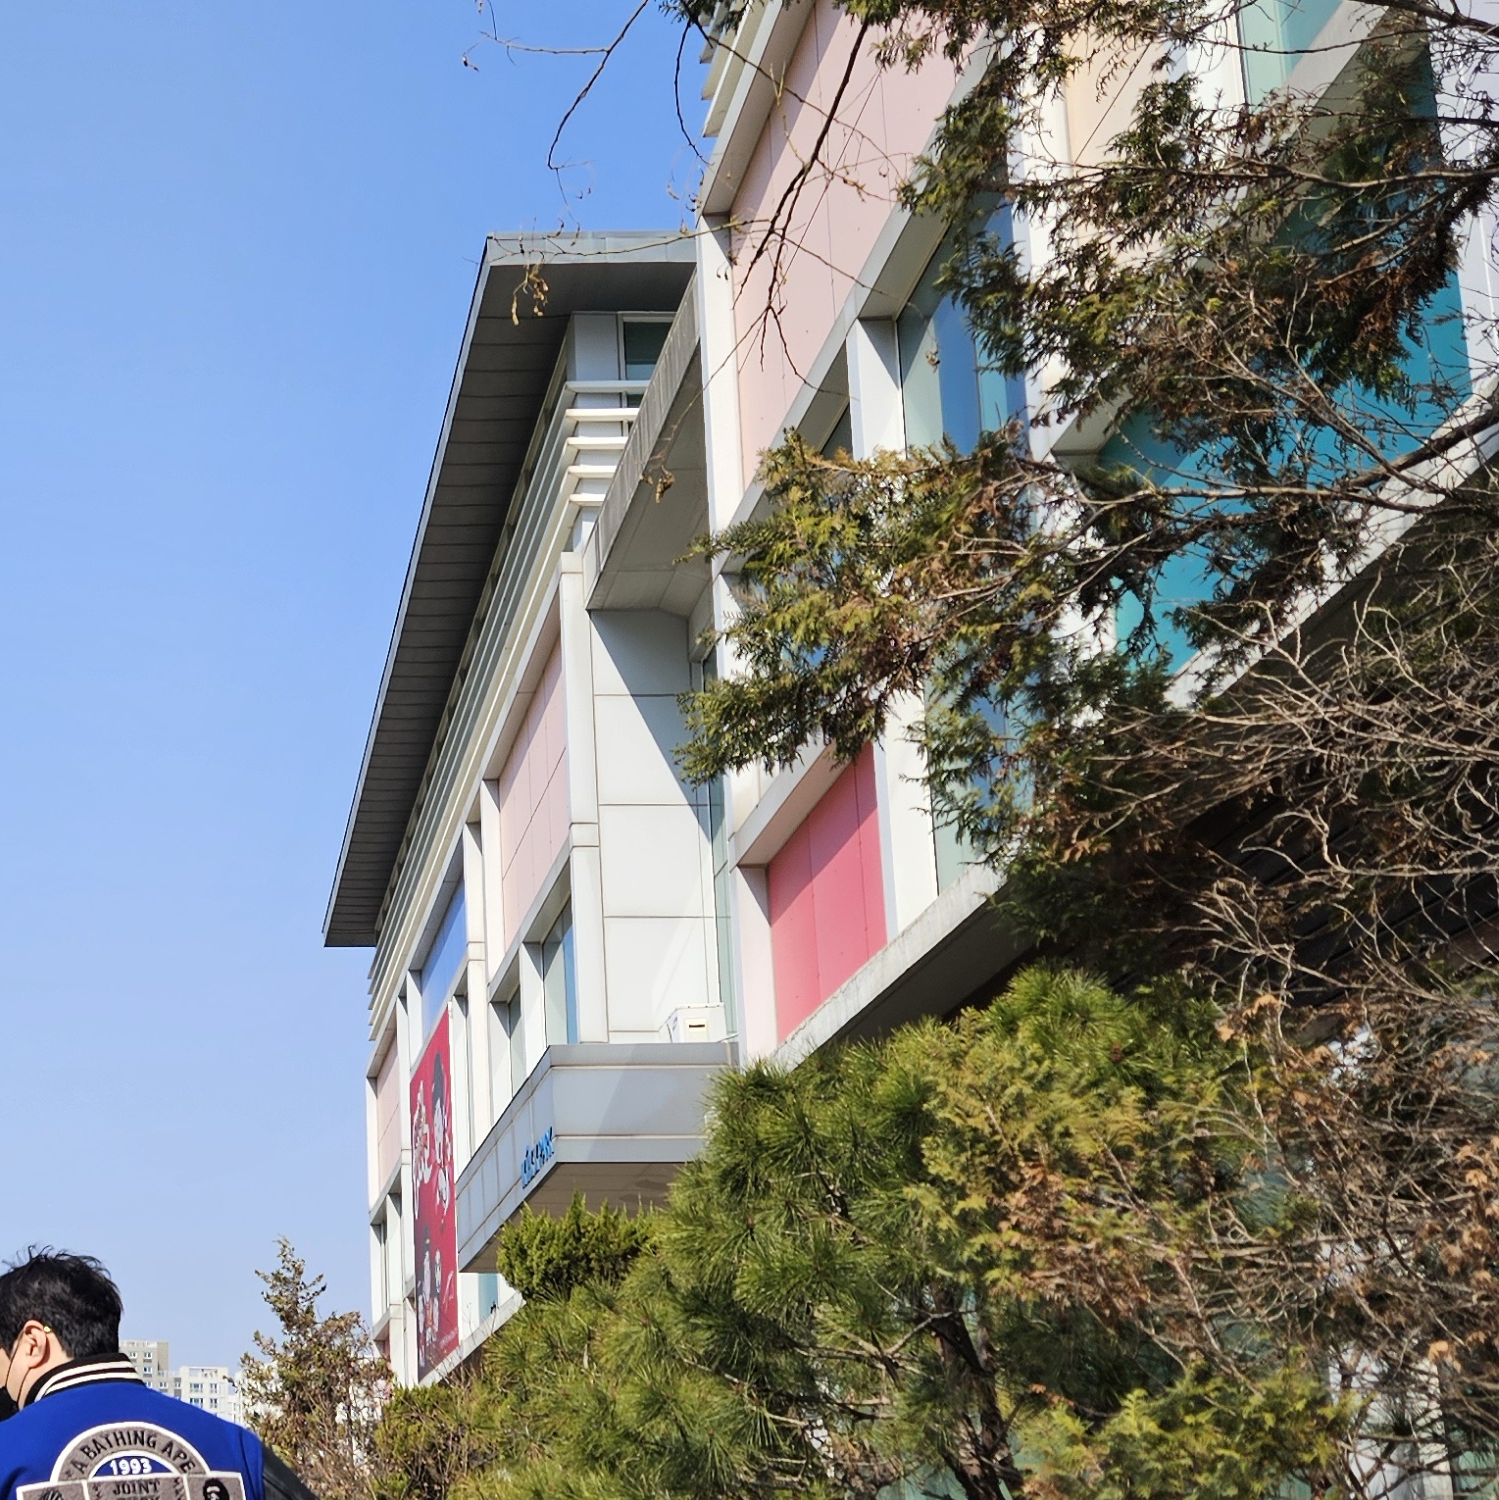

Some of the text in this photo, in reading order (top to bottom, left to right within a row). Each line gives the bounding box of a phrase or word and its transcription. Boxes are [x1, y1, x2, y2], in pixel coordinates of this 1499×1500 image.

[71, 1430, 196, 1474] A BATHING APE
[109, 1458, 153, 1476] 1993
[112, 1478, 160, 1495] JOINT
